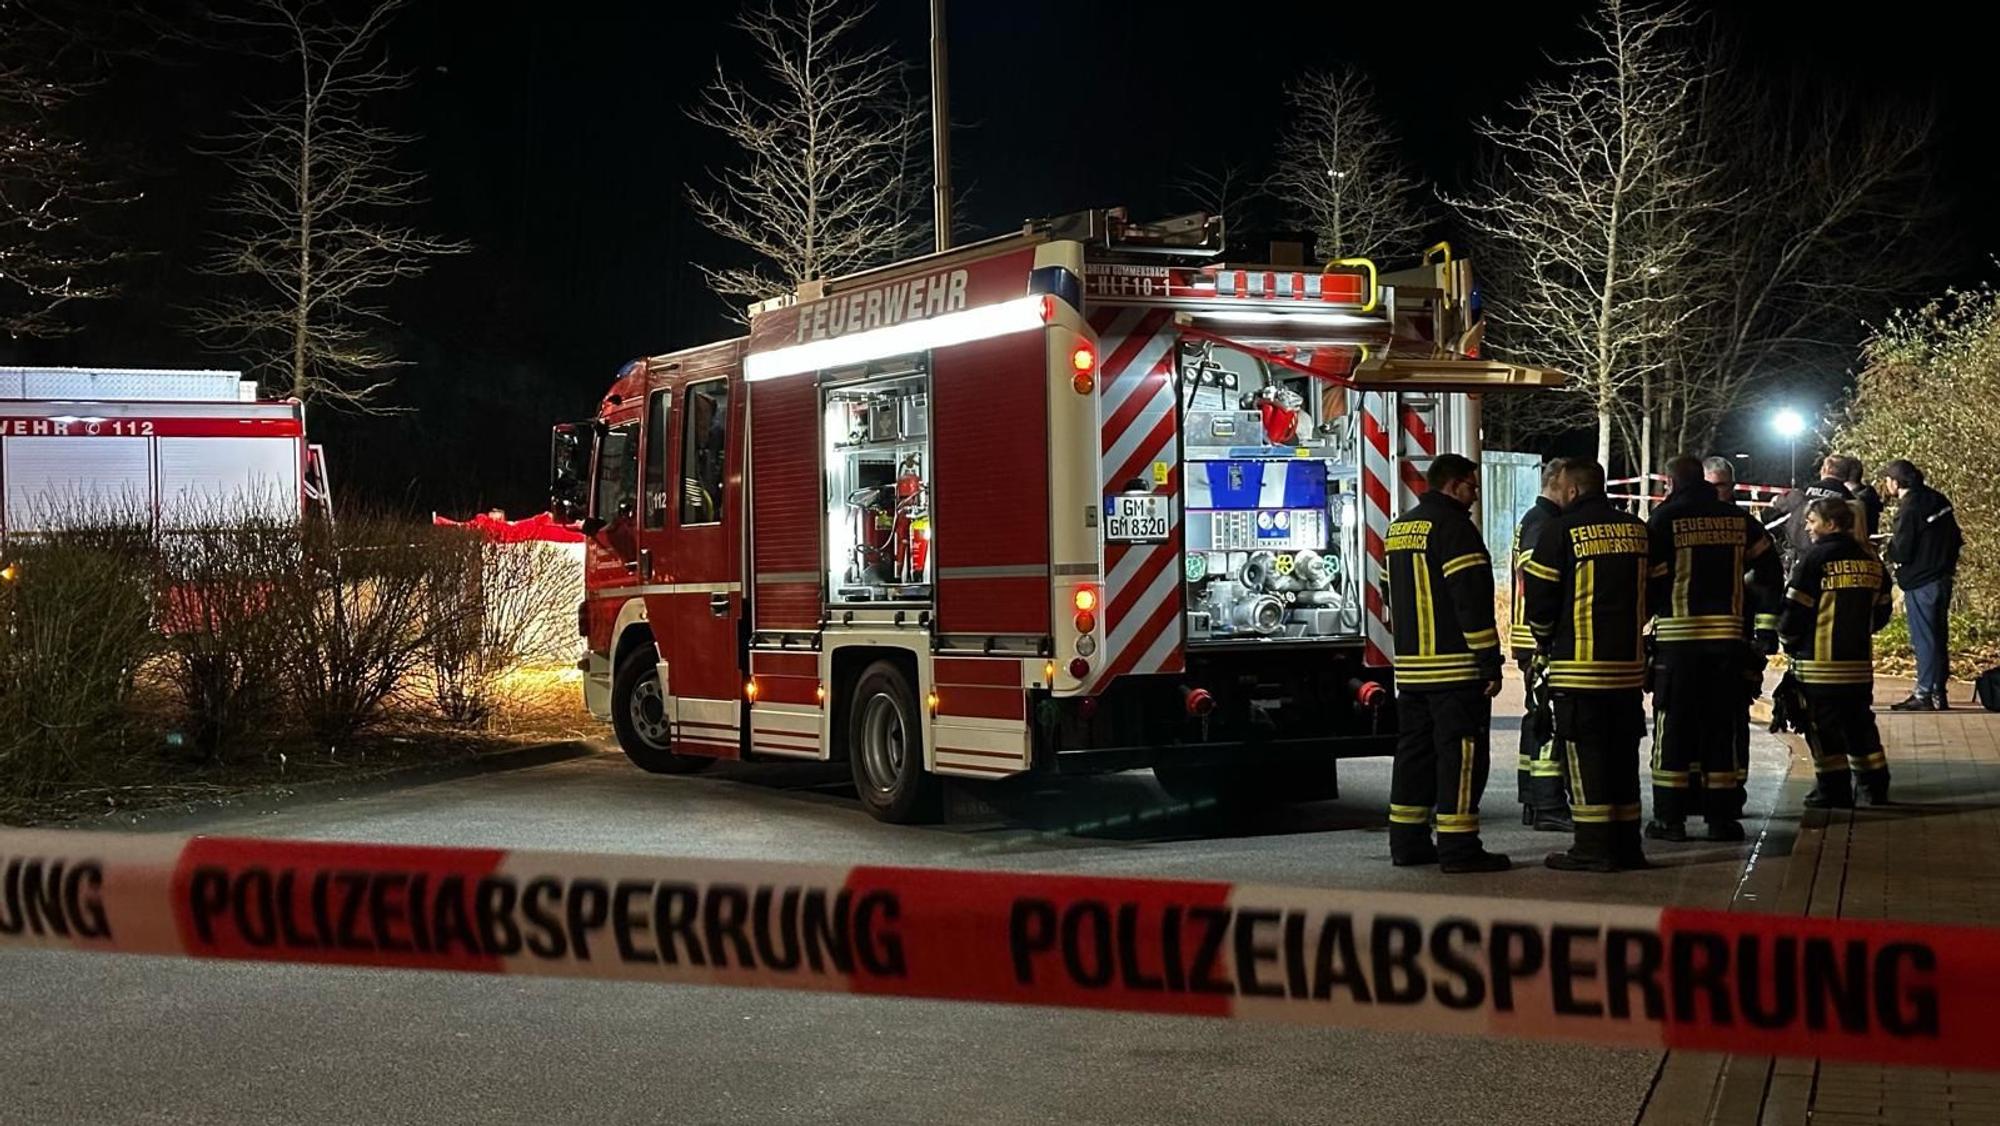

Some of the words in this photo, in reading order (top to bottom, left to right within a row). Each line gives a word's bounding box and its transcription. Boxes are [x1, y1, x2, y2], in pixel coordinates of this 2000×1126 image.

[797, 269, 968, 343] FEUERWEHR
[112, 421, 154, 436] 112
[653, 491, 667, 510] 112
[1123, 499, 1144, 517] GM
[1110, 518, 1129, 536] GM
[1131, 518, 1166, 536] 8320
[1569, 523, 1648, 543] FEUERWEHR
[1673, 516, 1746, 534] FEUERWEHR
[190, 866, 906, 978] POLIZEIABSPERRUNG
[1009, 898, 1938, 1039] POLIZEIABSPERRUNG
